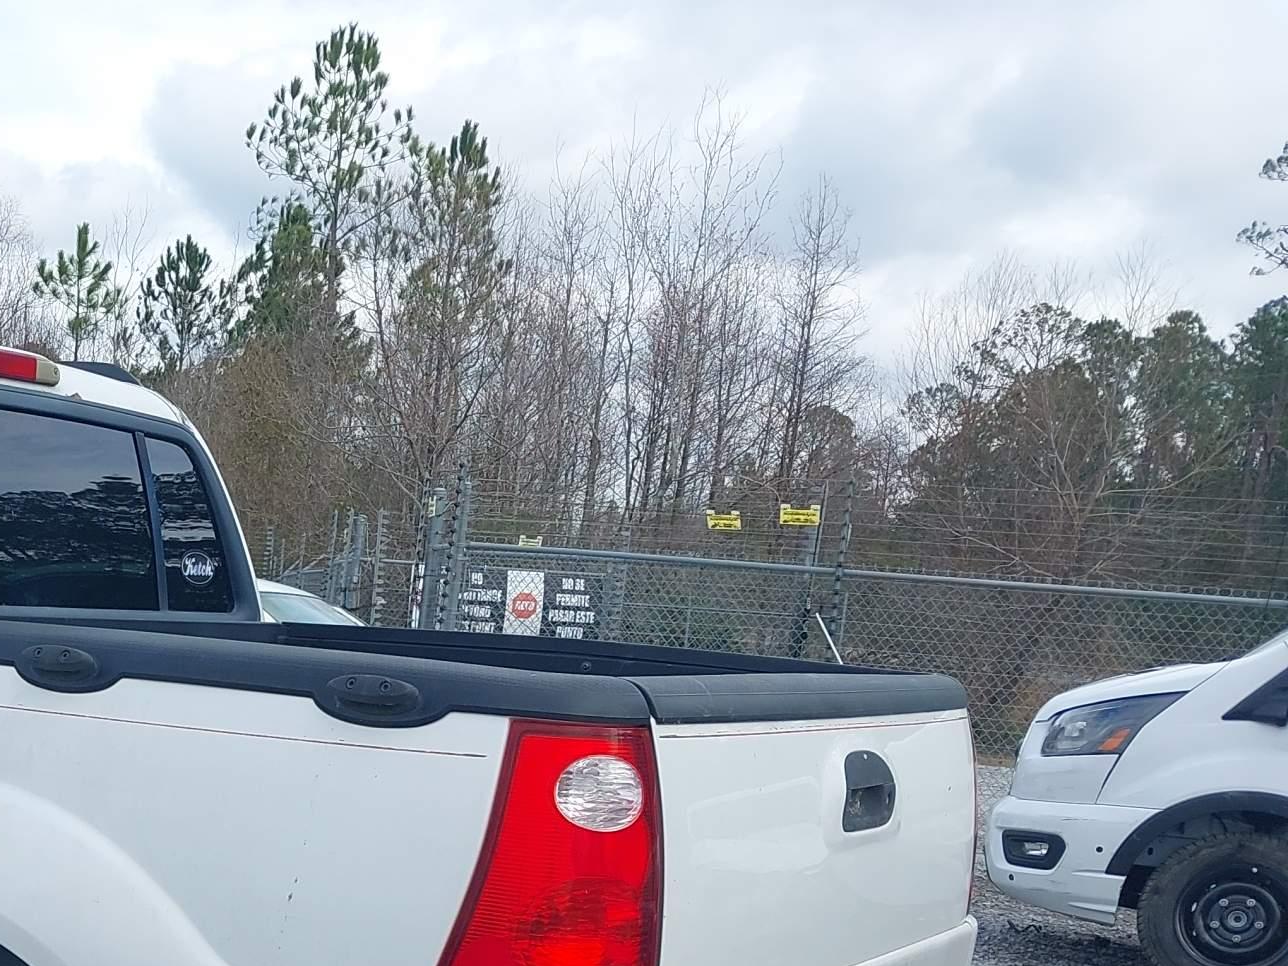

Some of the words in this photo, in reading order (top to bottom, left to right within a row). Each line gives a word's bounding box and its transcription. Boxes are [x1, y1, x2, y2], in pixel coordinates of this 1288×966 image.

[471, 572, 483, 585] NO
[562, 577, 574, 590] NO
[574, 578, 585, 591] SE
[556, 593, 590, 607] PERMITE
[548, 609, 575, 623] PASAR
[575, 610, 596, 624] ESTE
[555, 625, 584, 640] PUNTO
